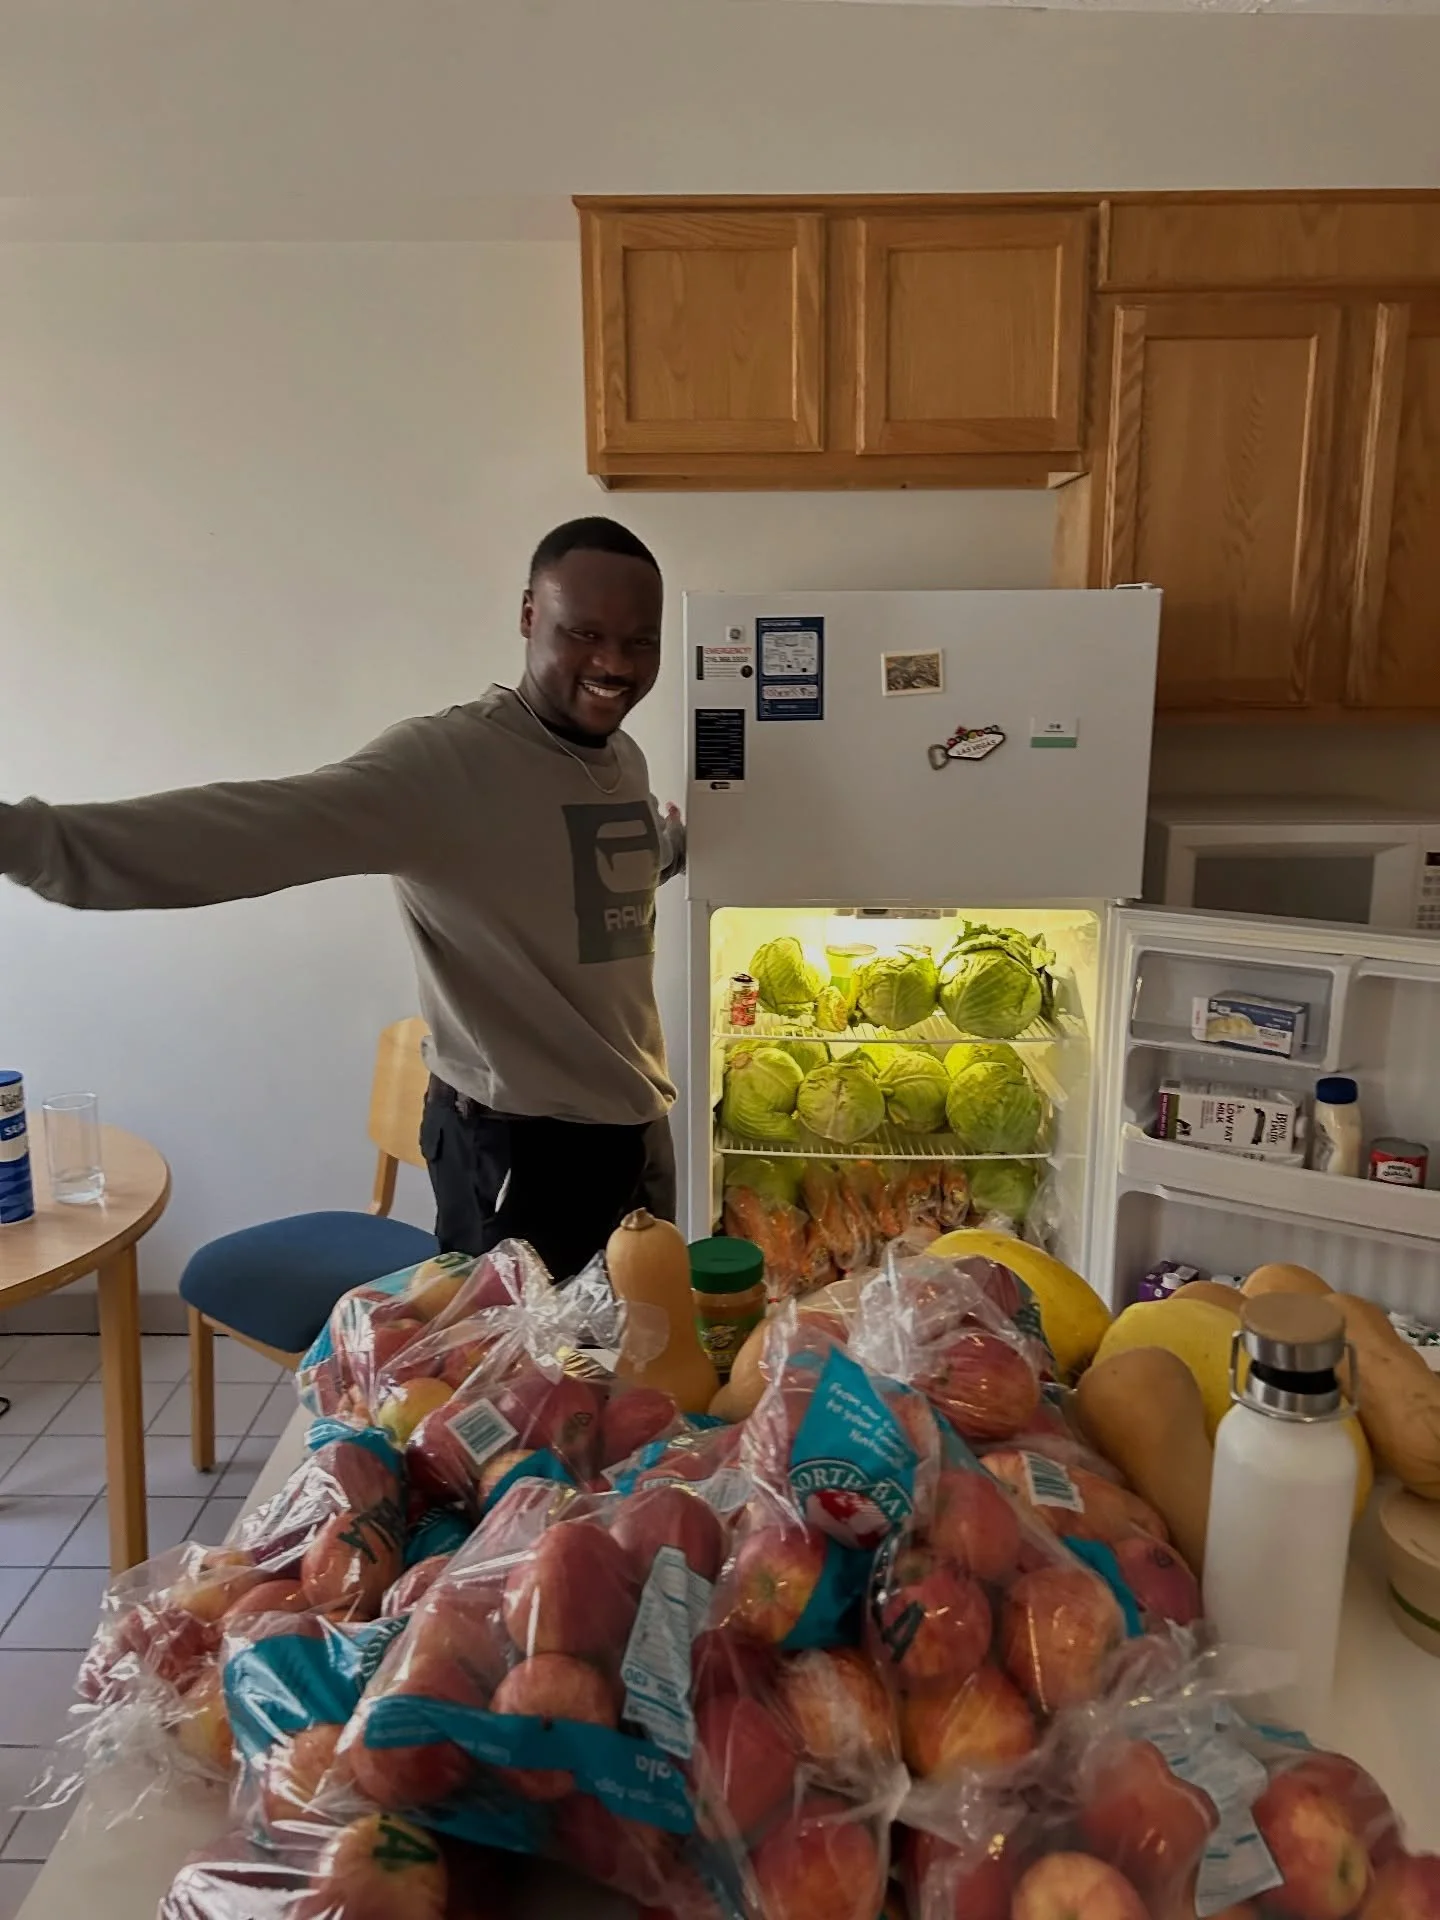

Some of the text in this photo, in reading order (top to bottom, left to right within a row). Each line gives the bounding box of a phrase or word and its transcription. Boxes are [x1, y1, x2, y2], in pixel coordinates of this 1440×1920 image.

[1215, 1102, 1226, 1124] MILK
[1224, 1103, 1236, 1143] LOW FAT
[793, 1467, 863, 1492] ORTH
[635, 1753, 676, 1786] ala
